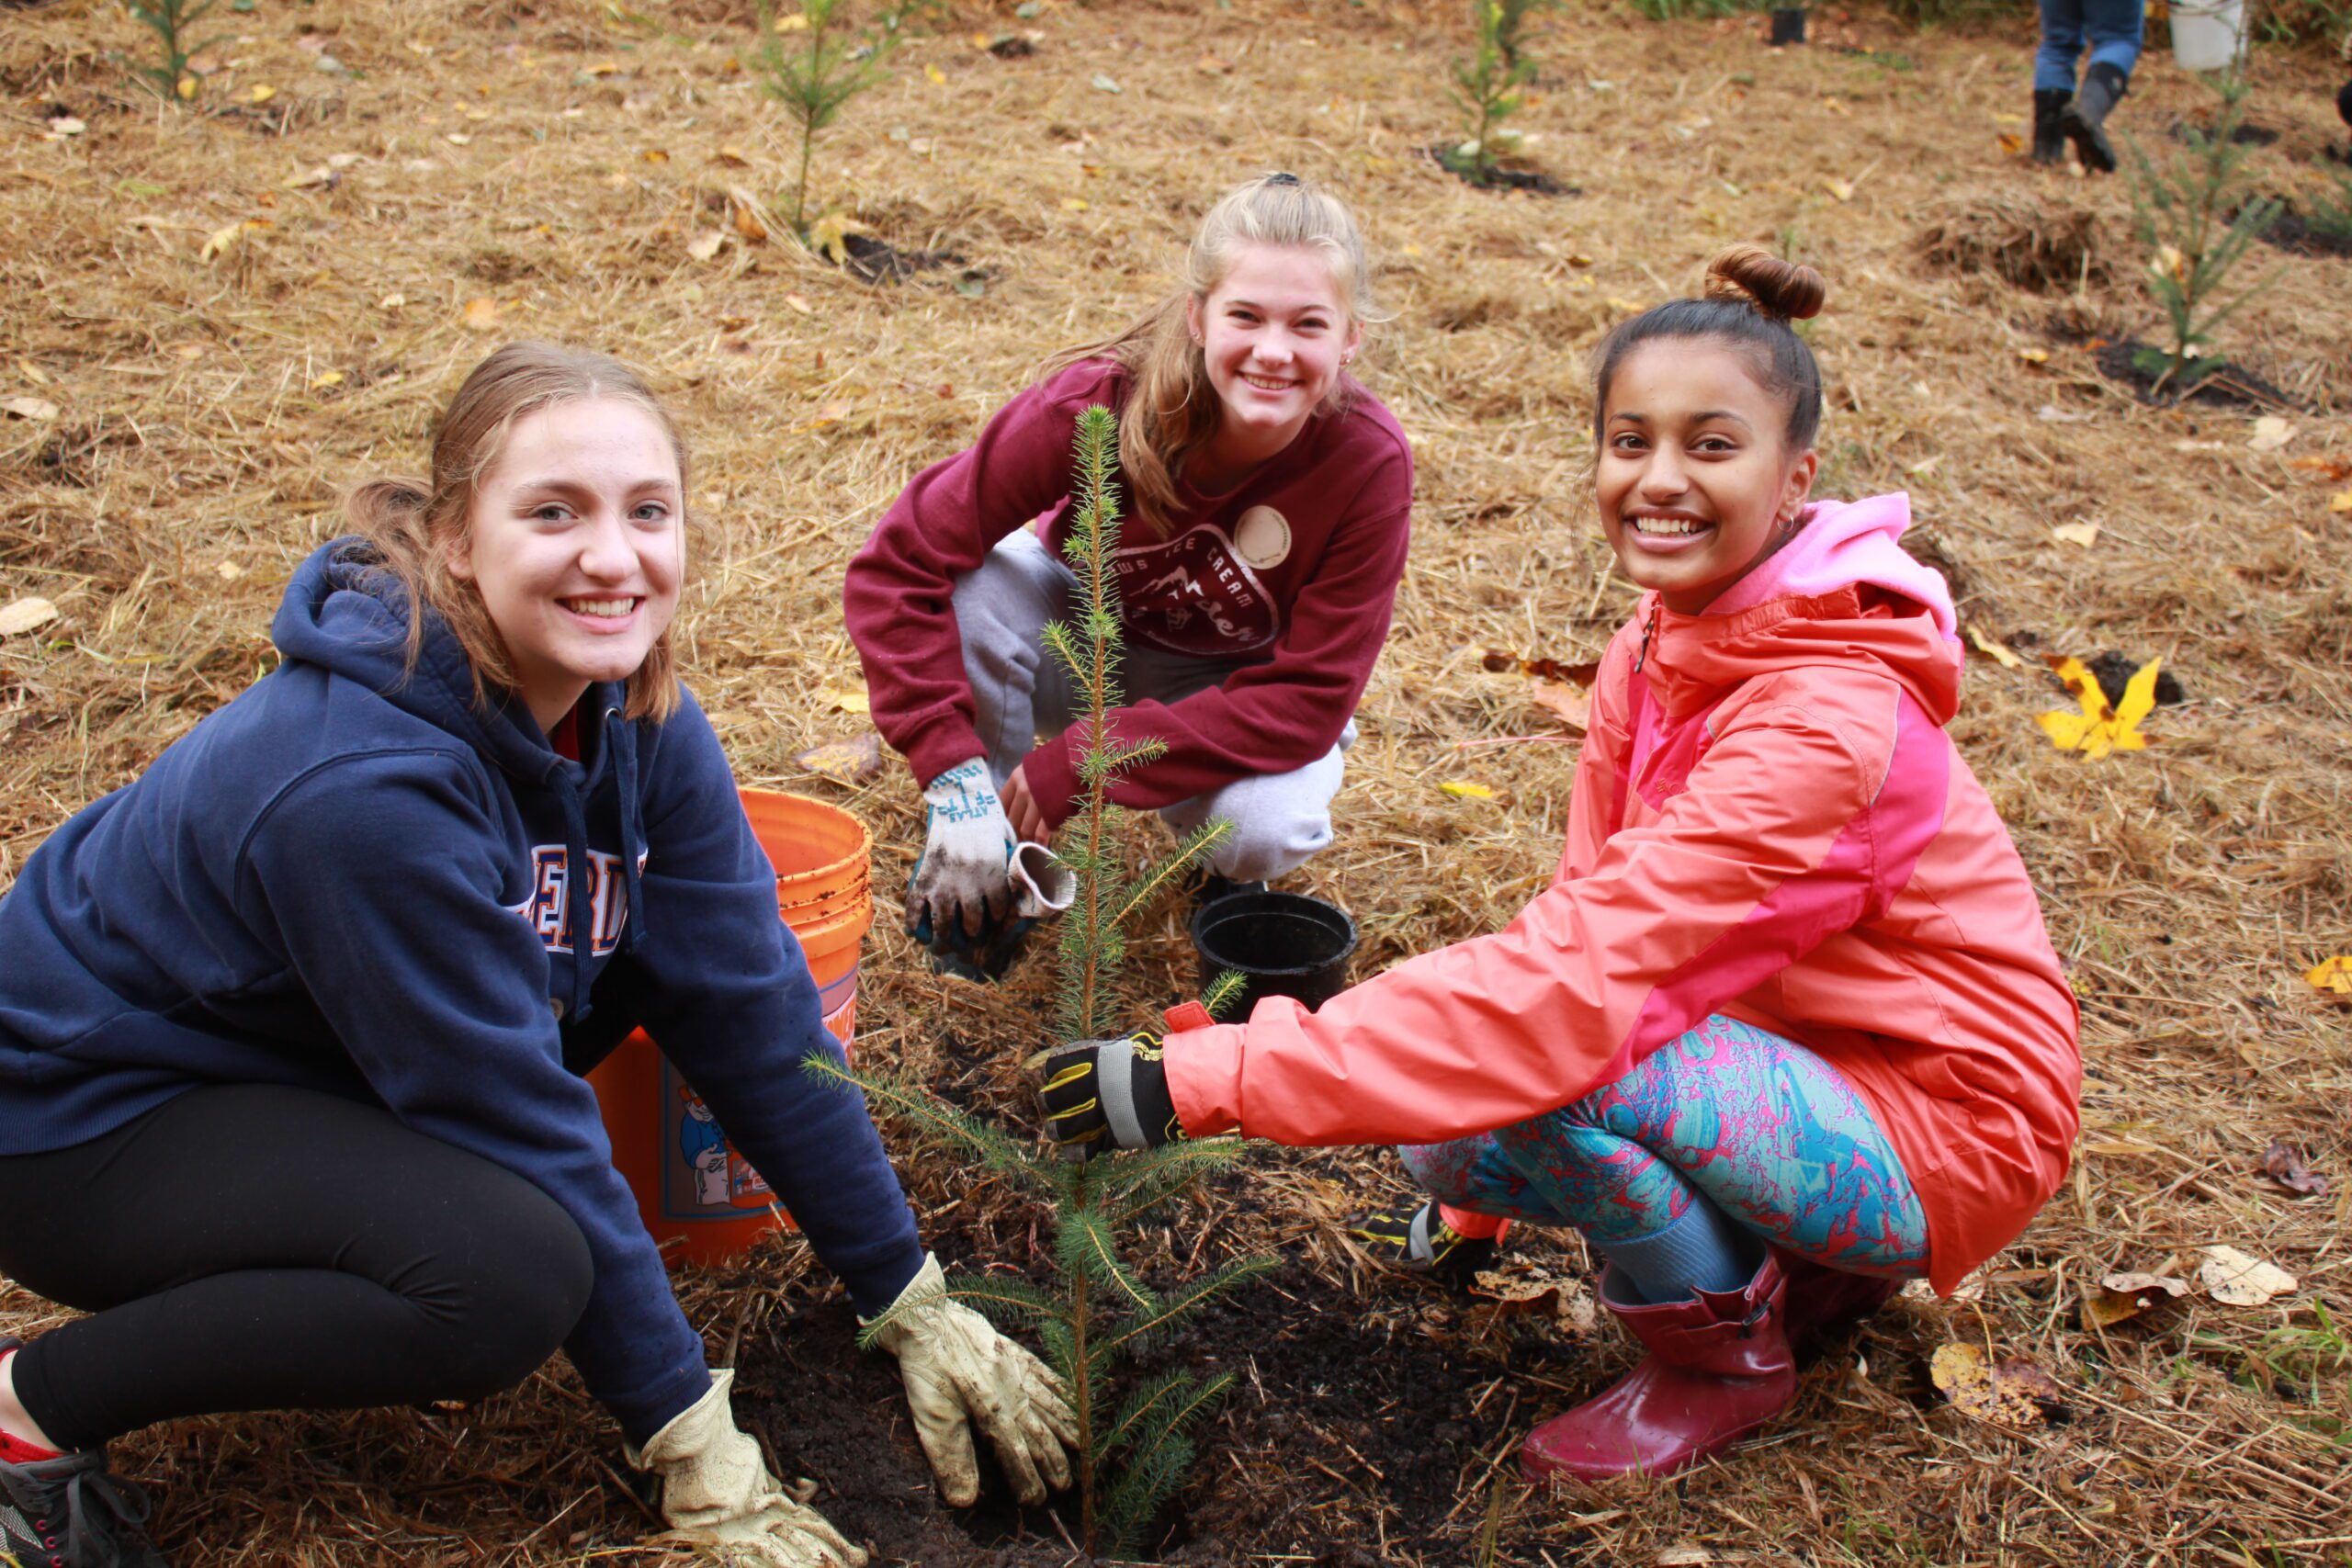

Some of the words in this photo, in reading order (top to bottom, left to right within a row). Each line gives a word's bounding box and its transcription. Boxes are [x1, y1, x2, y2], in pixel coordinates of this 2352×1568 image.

[1165, 537, 1196, 558] ICE
[1208, 547, 1253, 607] CREAM
[950, 806, 989, 823] ATLAS
